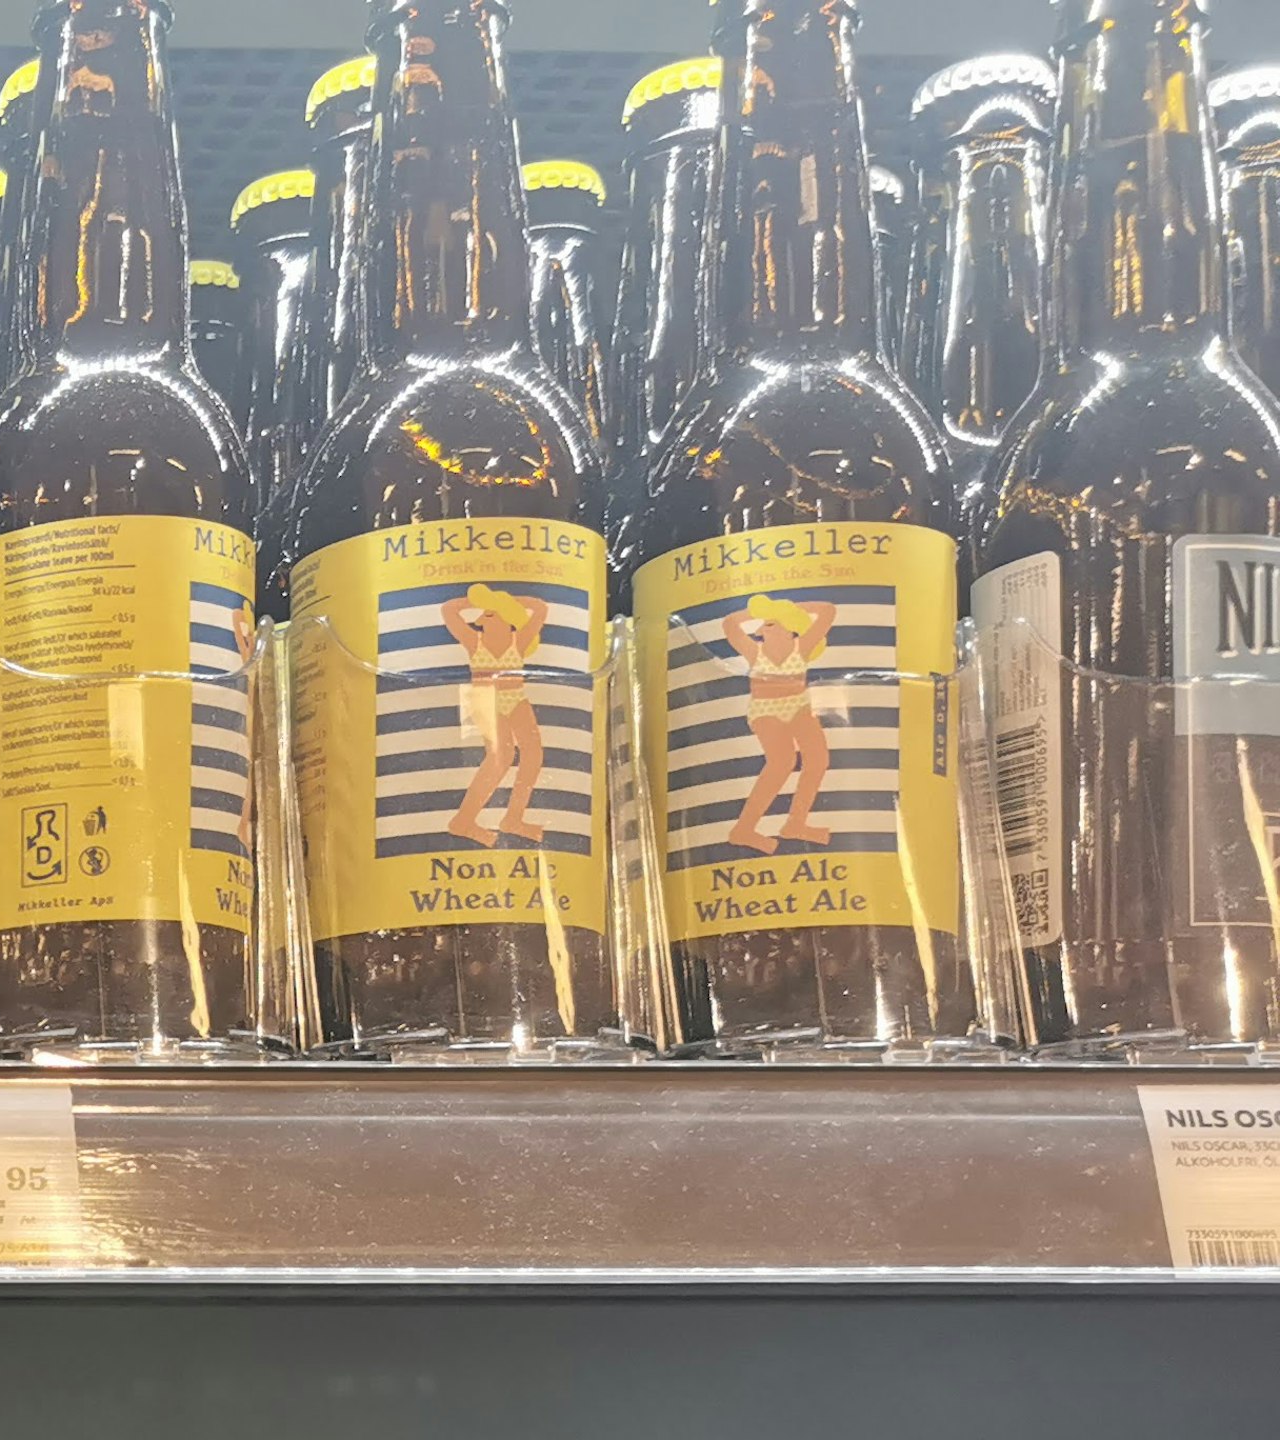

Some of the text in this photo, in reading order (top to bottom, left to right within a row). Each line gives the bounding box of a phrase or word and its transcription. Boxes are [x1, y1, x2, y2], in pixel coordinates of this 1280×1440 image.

[383, 526, 588, 561] Mikkeller
[673, 529, 893, 581] Mikkeller
[429, 856, 557, 881] Non Alc
[711, 861, 849, 892] Non Alc
[18, 898, 82, 912] Mikkeller
[409, 890, 516, 912] Wheat
[694, 890, 867, 923] Wheat Ale
[1165, 1109, 1228, 1128] NILS
[1171, 1140, 1249, 1152] NILS OSCAR,
[6, 1167, 48, 1191] 95
